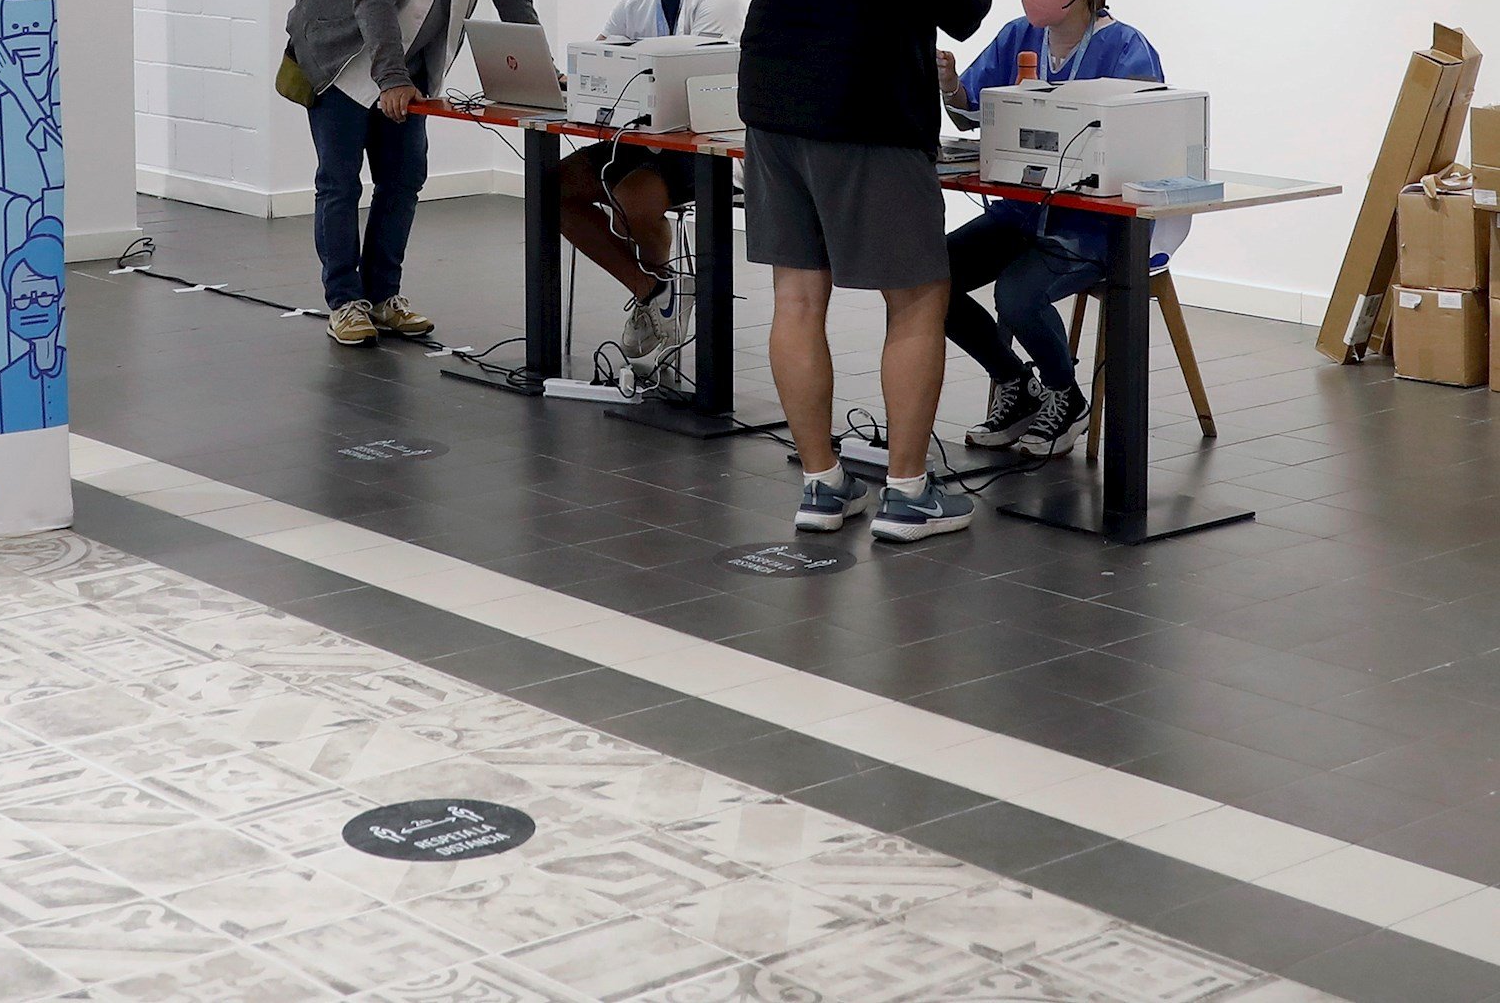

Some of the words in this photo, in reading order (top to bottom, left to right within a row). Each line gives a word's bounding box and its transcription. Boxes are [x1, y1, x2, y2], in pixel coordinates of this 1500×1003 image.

[413, 829, 478, 850] RESPETA
[471, 824, 498, 835] LA
[435, 832, 511, 856] DISTANCIA
